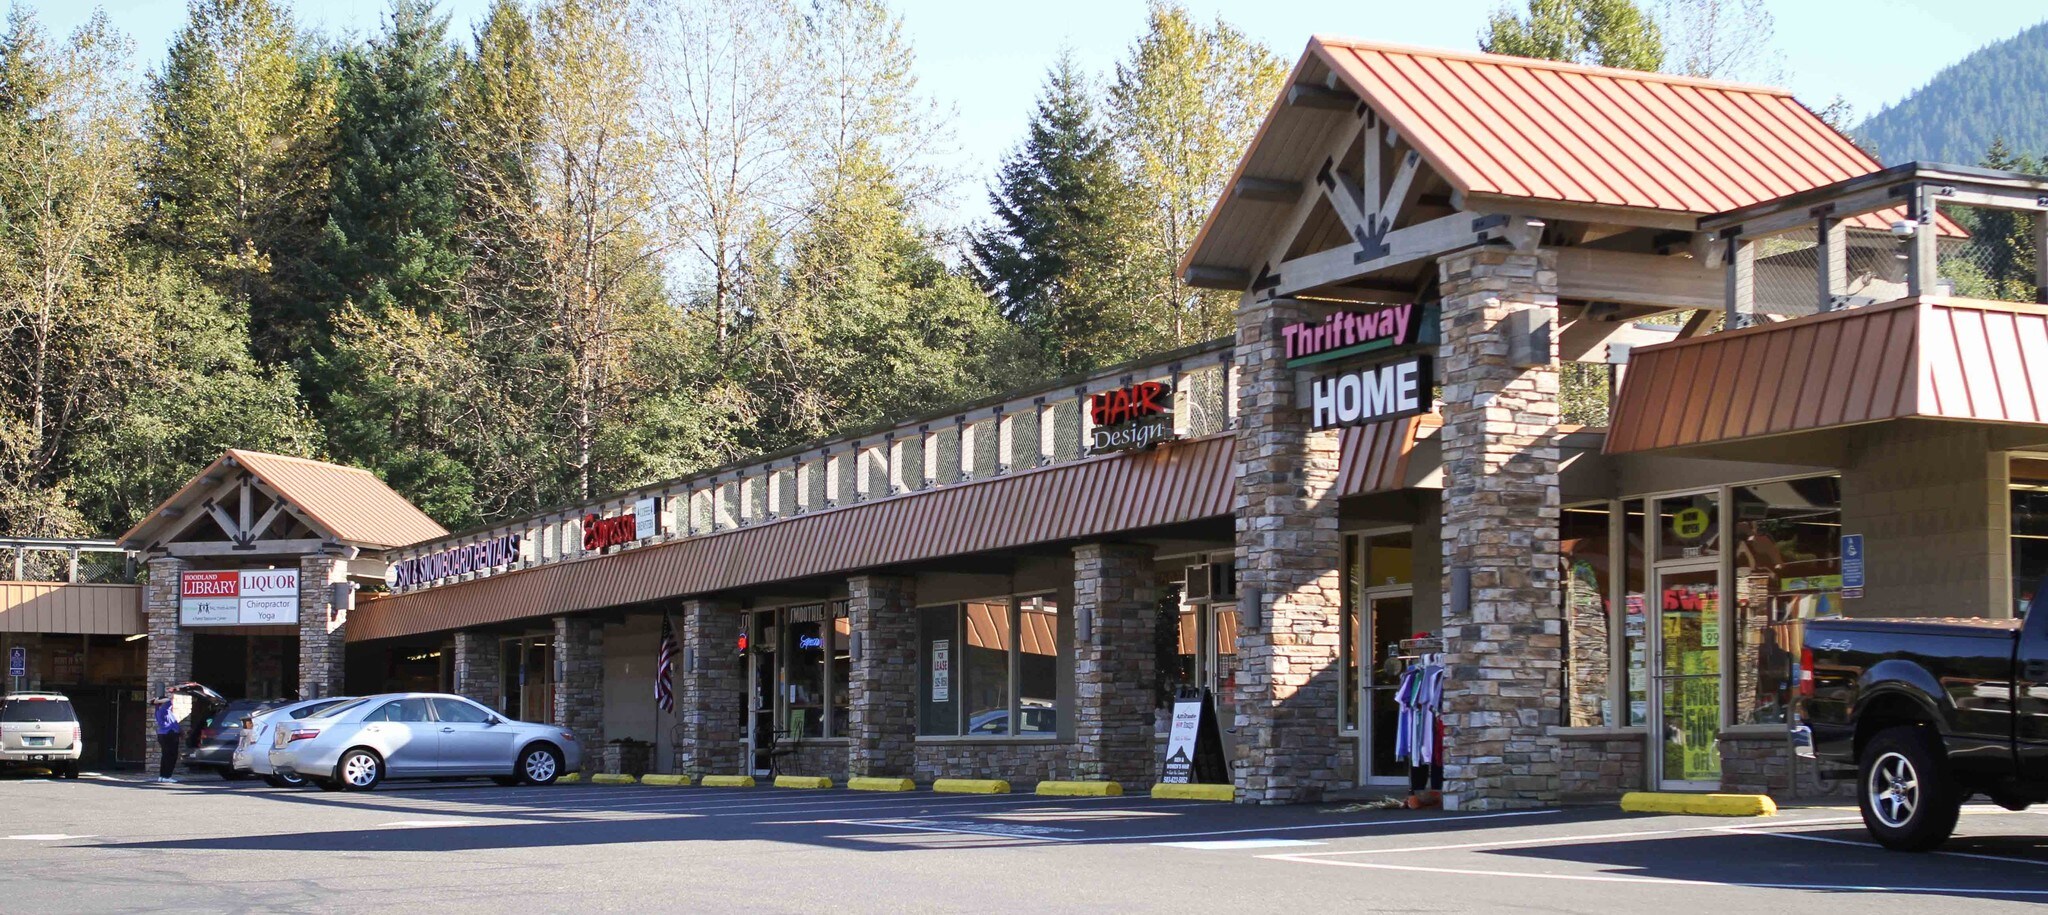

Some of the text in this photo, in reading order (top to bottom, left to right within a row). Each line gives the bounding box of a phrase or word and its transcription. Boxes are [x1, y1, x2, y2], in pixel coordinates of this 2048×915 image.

[1282, 304, 1412, 359] Thriftway
[1313, 361, 1418, 428] HOME
[1091, 382, 1166, 425] HAIR
[1093, 423, 1162, 450] Design
[399, 535, 515, 586] SKI & SNOWBOARD RENTALS
[183, 580, 237, 595] LIBRARY
[242, 575, 295, 592] LIQUOR
[246, 600, 290, 609] Chiropractor
[258, 612, 276, 621] Yoga
[1820, 638, 1853, 652] 4x4
[934, 660, 948, 671] LEASE
